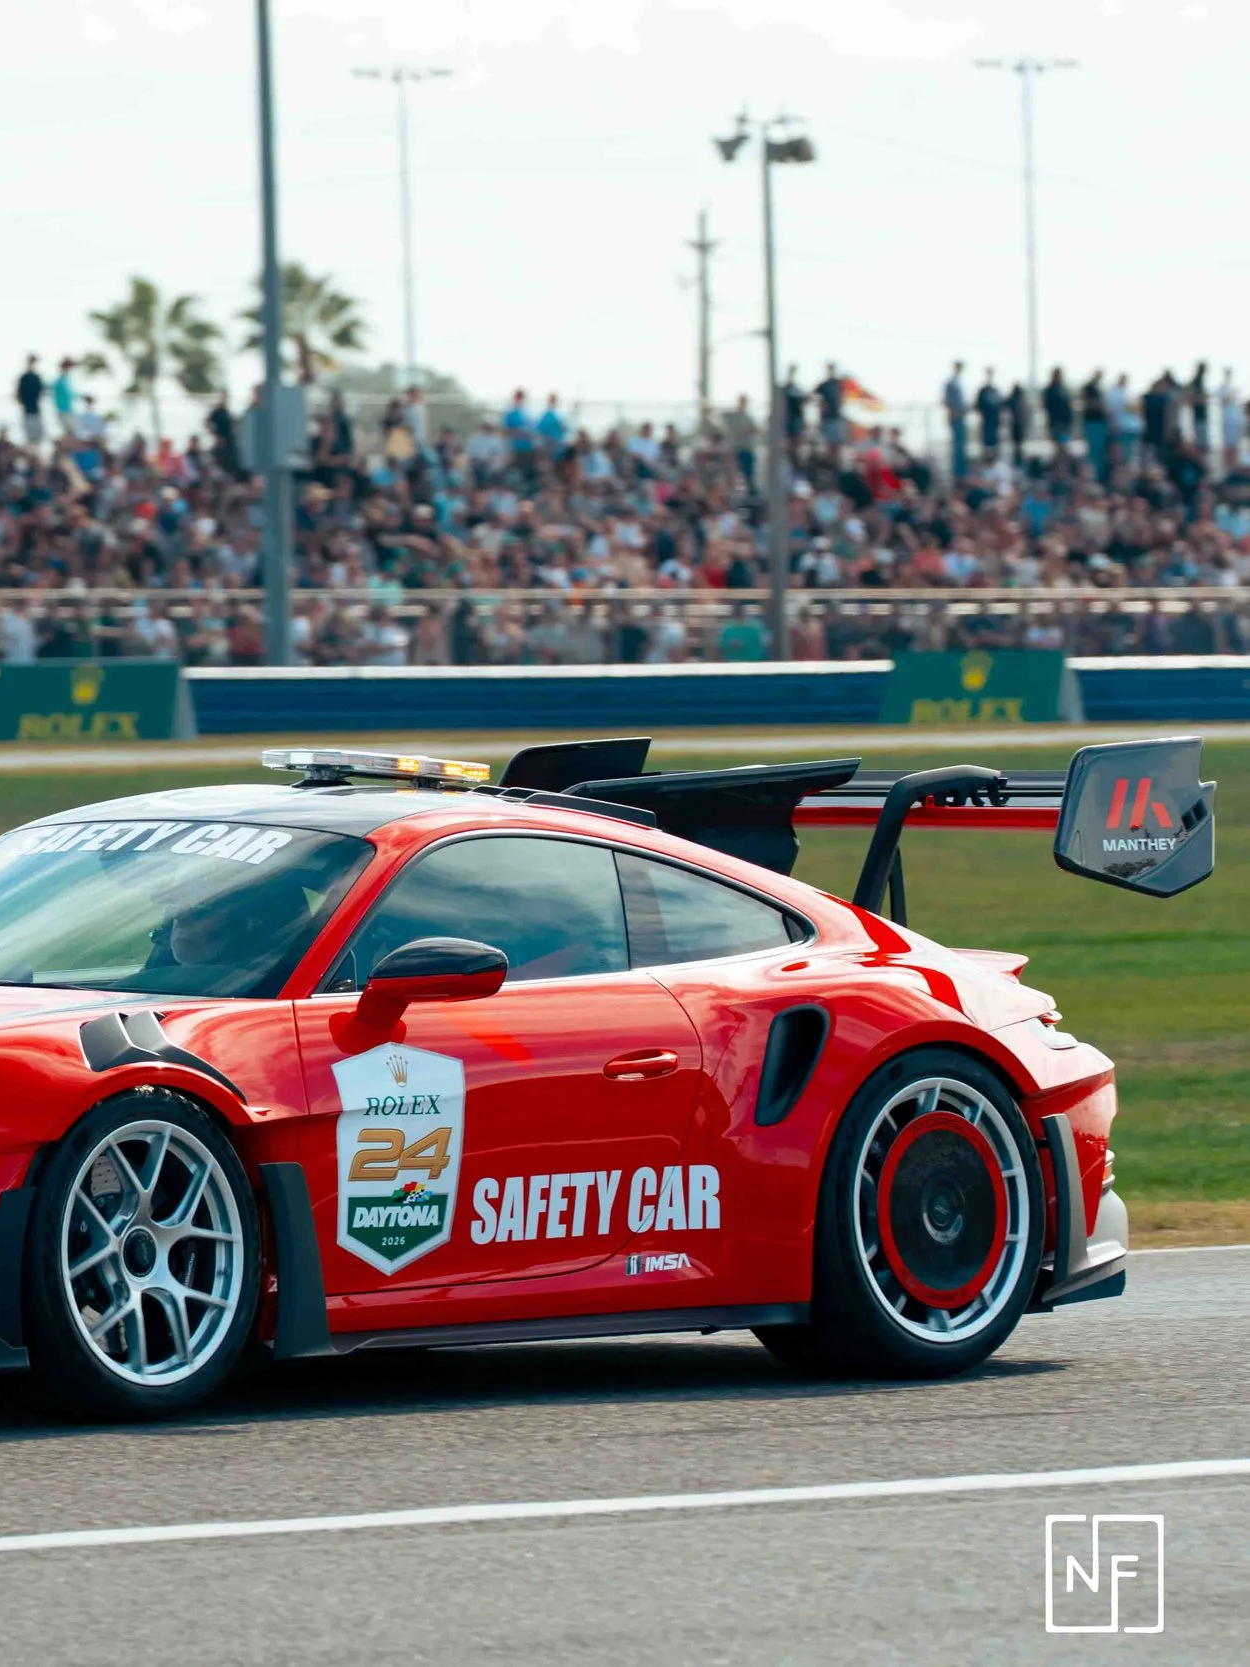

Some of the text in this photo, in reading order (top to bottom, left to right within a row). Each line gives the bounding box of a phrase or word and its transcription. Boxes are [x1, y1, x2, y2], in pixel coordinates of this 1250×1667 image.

[911, 698, 1023, 725] ROLEX
[18, 713, 139, 741] ROLEX
[20, 822, 293, 865] SAFETY CAR
[1102, 838, 1177, 852] MANTHEY
[363, 1094, 442, 1116] ROLEX
[348, 1127, 452, 1181] 24
[352, 1205, 442, 1228] DAYTONA
[470, 1164, 721, 1245] SAFETY CAR
[381, 1236, 406, 1246] 2026
[645, 1252, 692, 1272] IMSA
